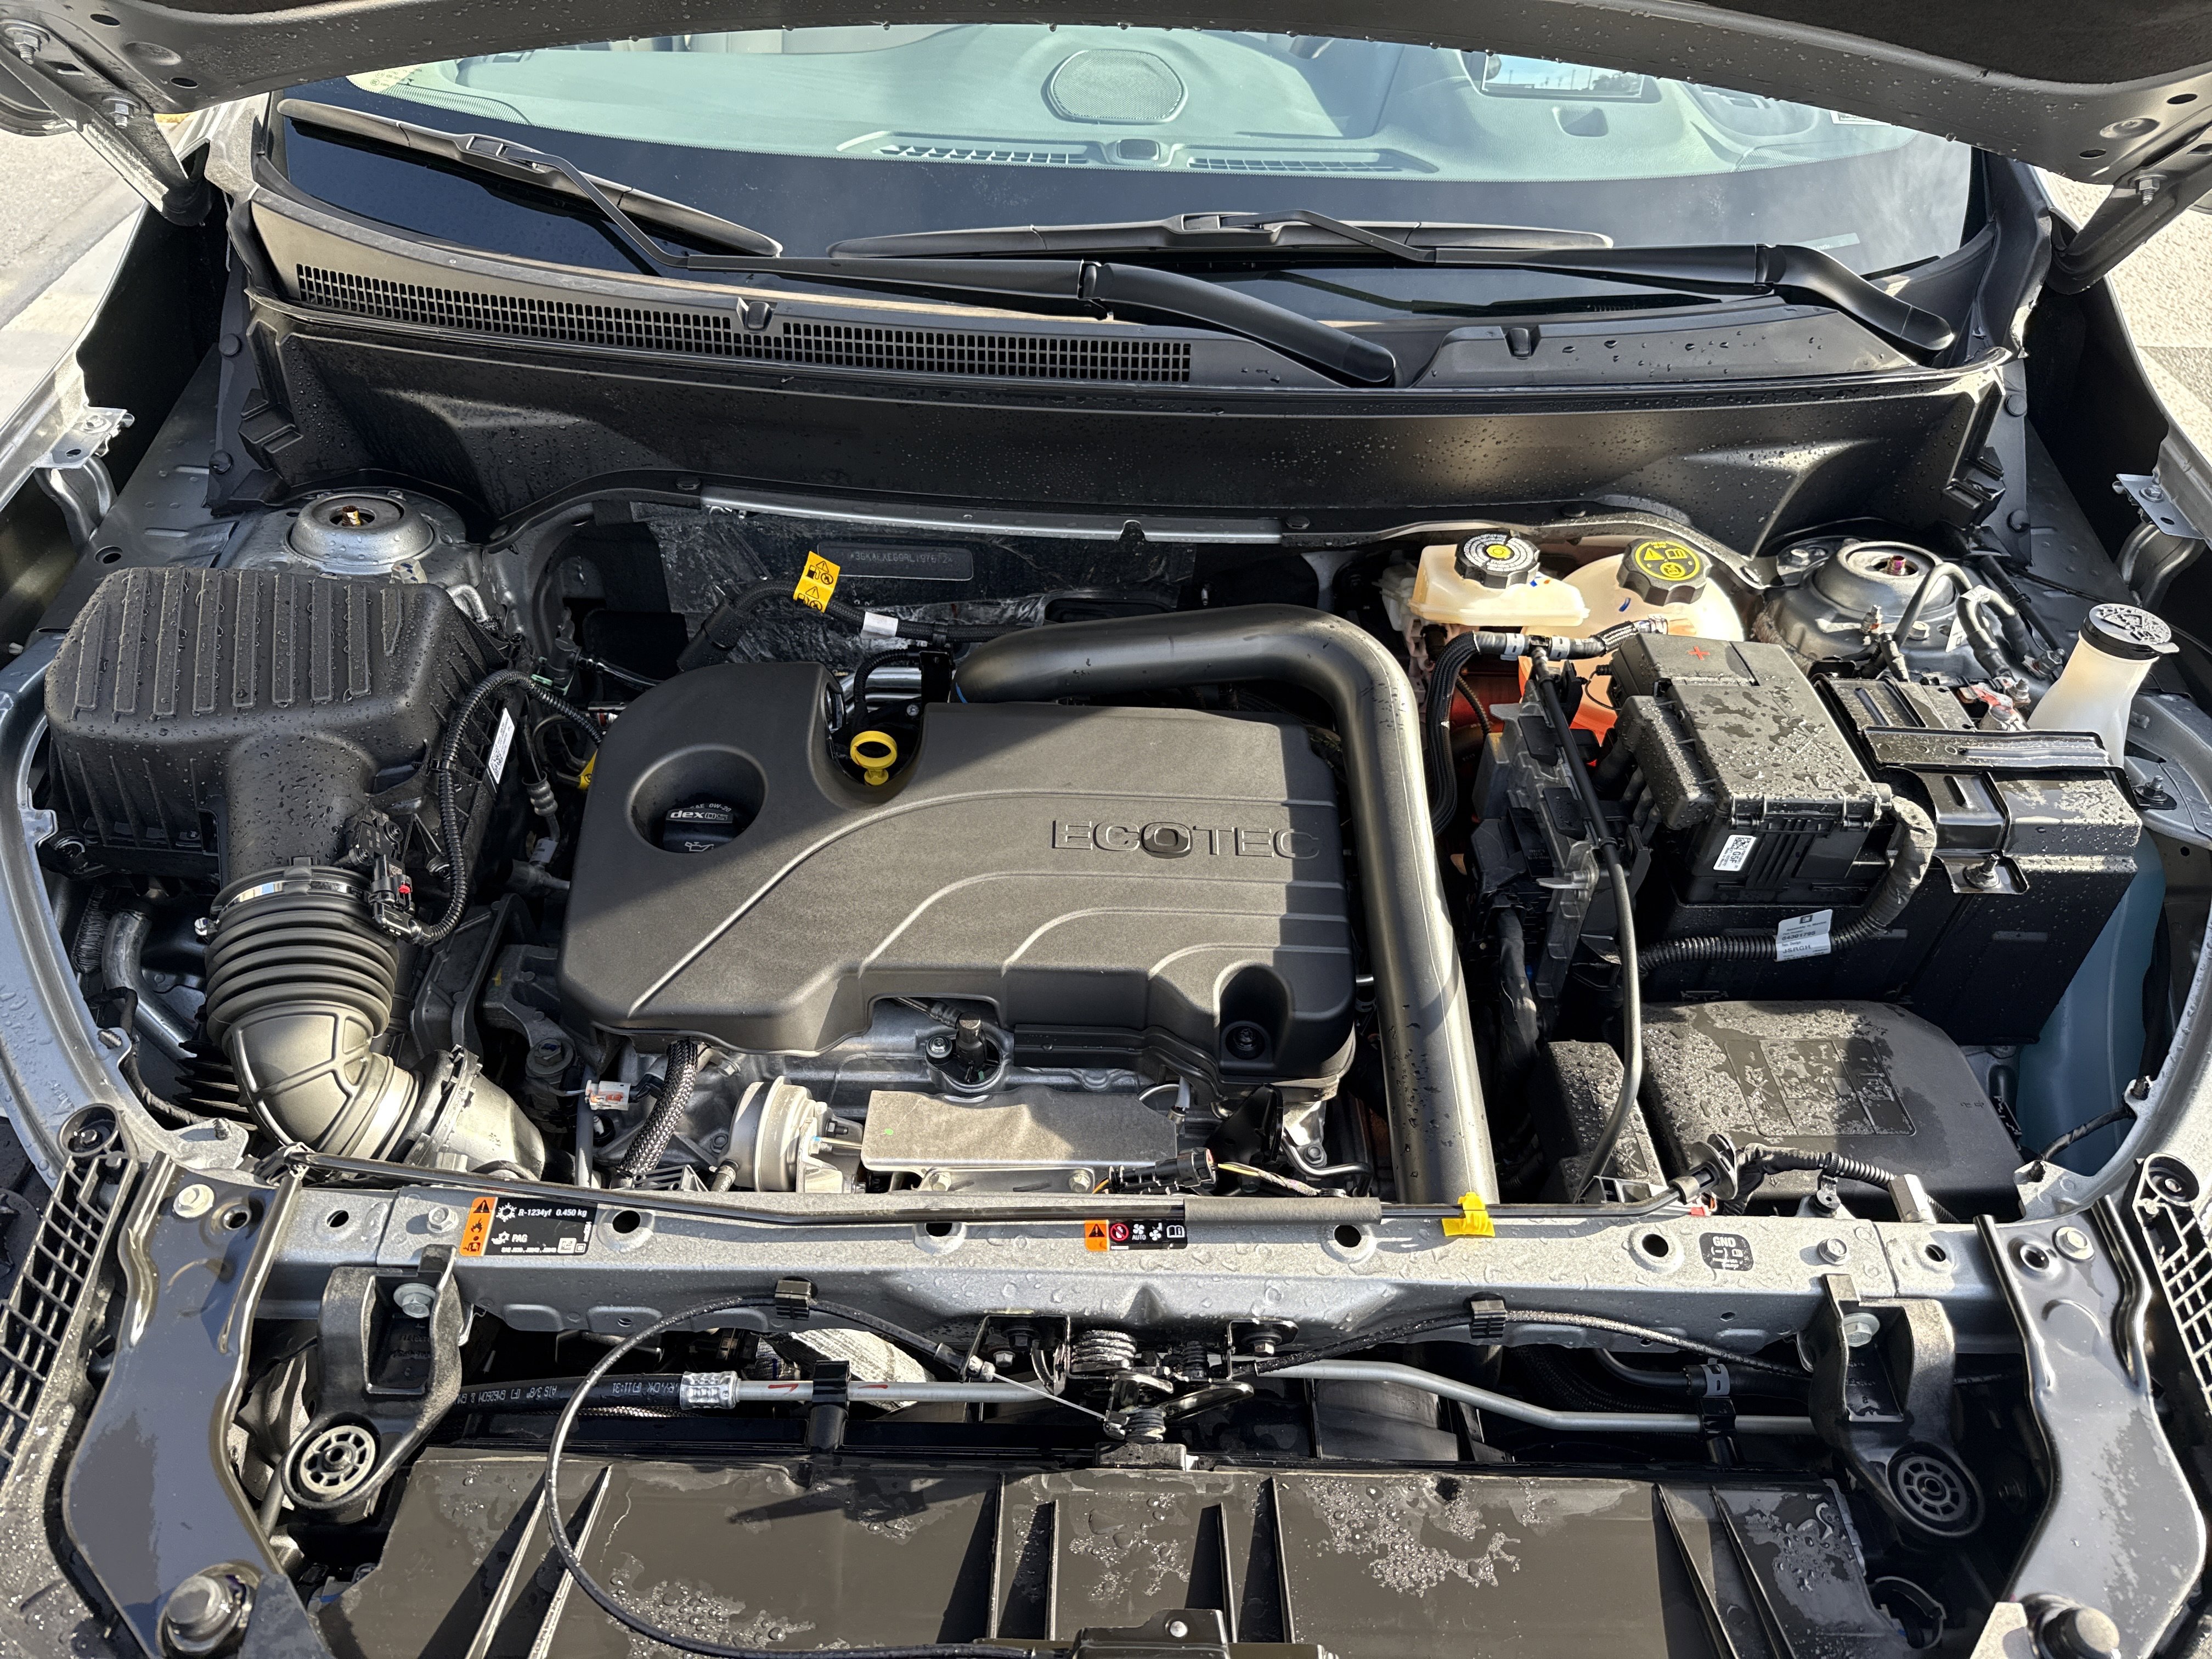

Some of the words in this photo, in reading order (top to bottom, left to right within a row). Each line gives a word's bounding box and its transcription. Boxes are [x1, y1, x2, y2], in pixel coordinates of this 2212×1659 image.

[709, 803, 731, 812] 0W-20
[670, 810, 729, 821] dexos
[1052, 820, 1319, 860] ECOTEC
[578, 1210, 588, 1218] kg
[511, 1234, 528, 1243] PAG
[1712, 1236, 1736, 1247] GND
